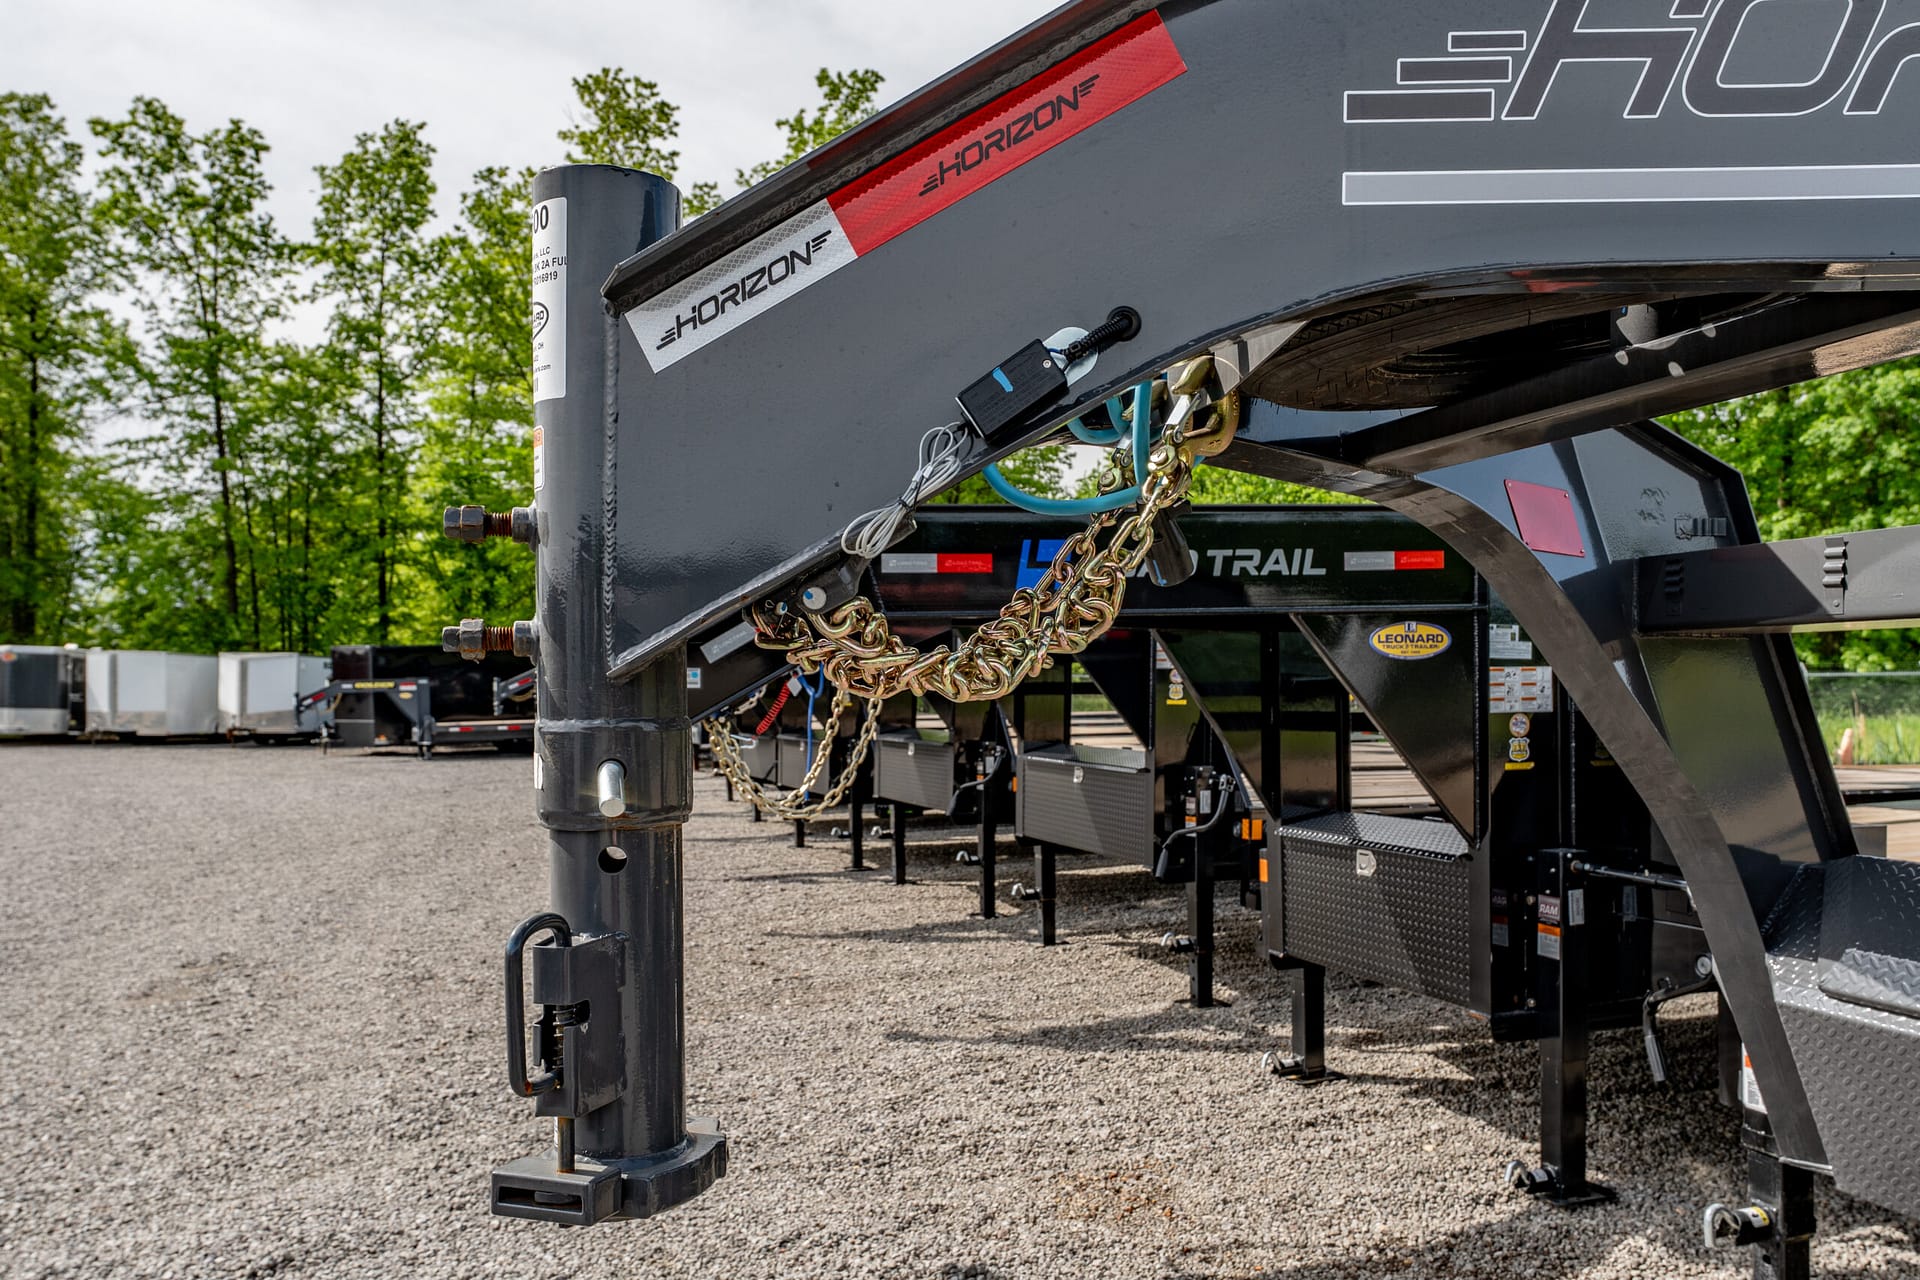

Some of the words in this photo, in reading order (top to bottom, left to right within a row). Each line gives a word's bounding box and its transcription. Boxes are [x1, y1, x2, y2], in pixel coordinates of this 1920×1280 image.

[938, 85, 1080, 186] HORIZON
[540, 246, 551, 257] LLC
[541, 258, 550, 270] 2A
[675, 240, 813, 339] HORIZON
[1206, 548, 1327, 577] TRAIL
[1377, 633, 1445, 644] LEONARD
[1540, 903, 1559, 917] RAM
